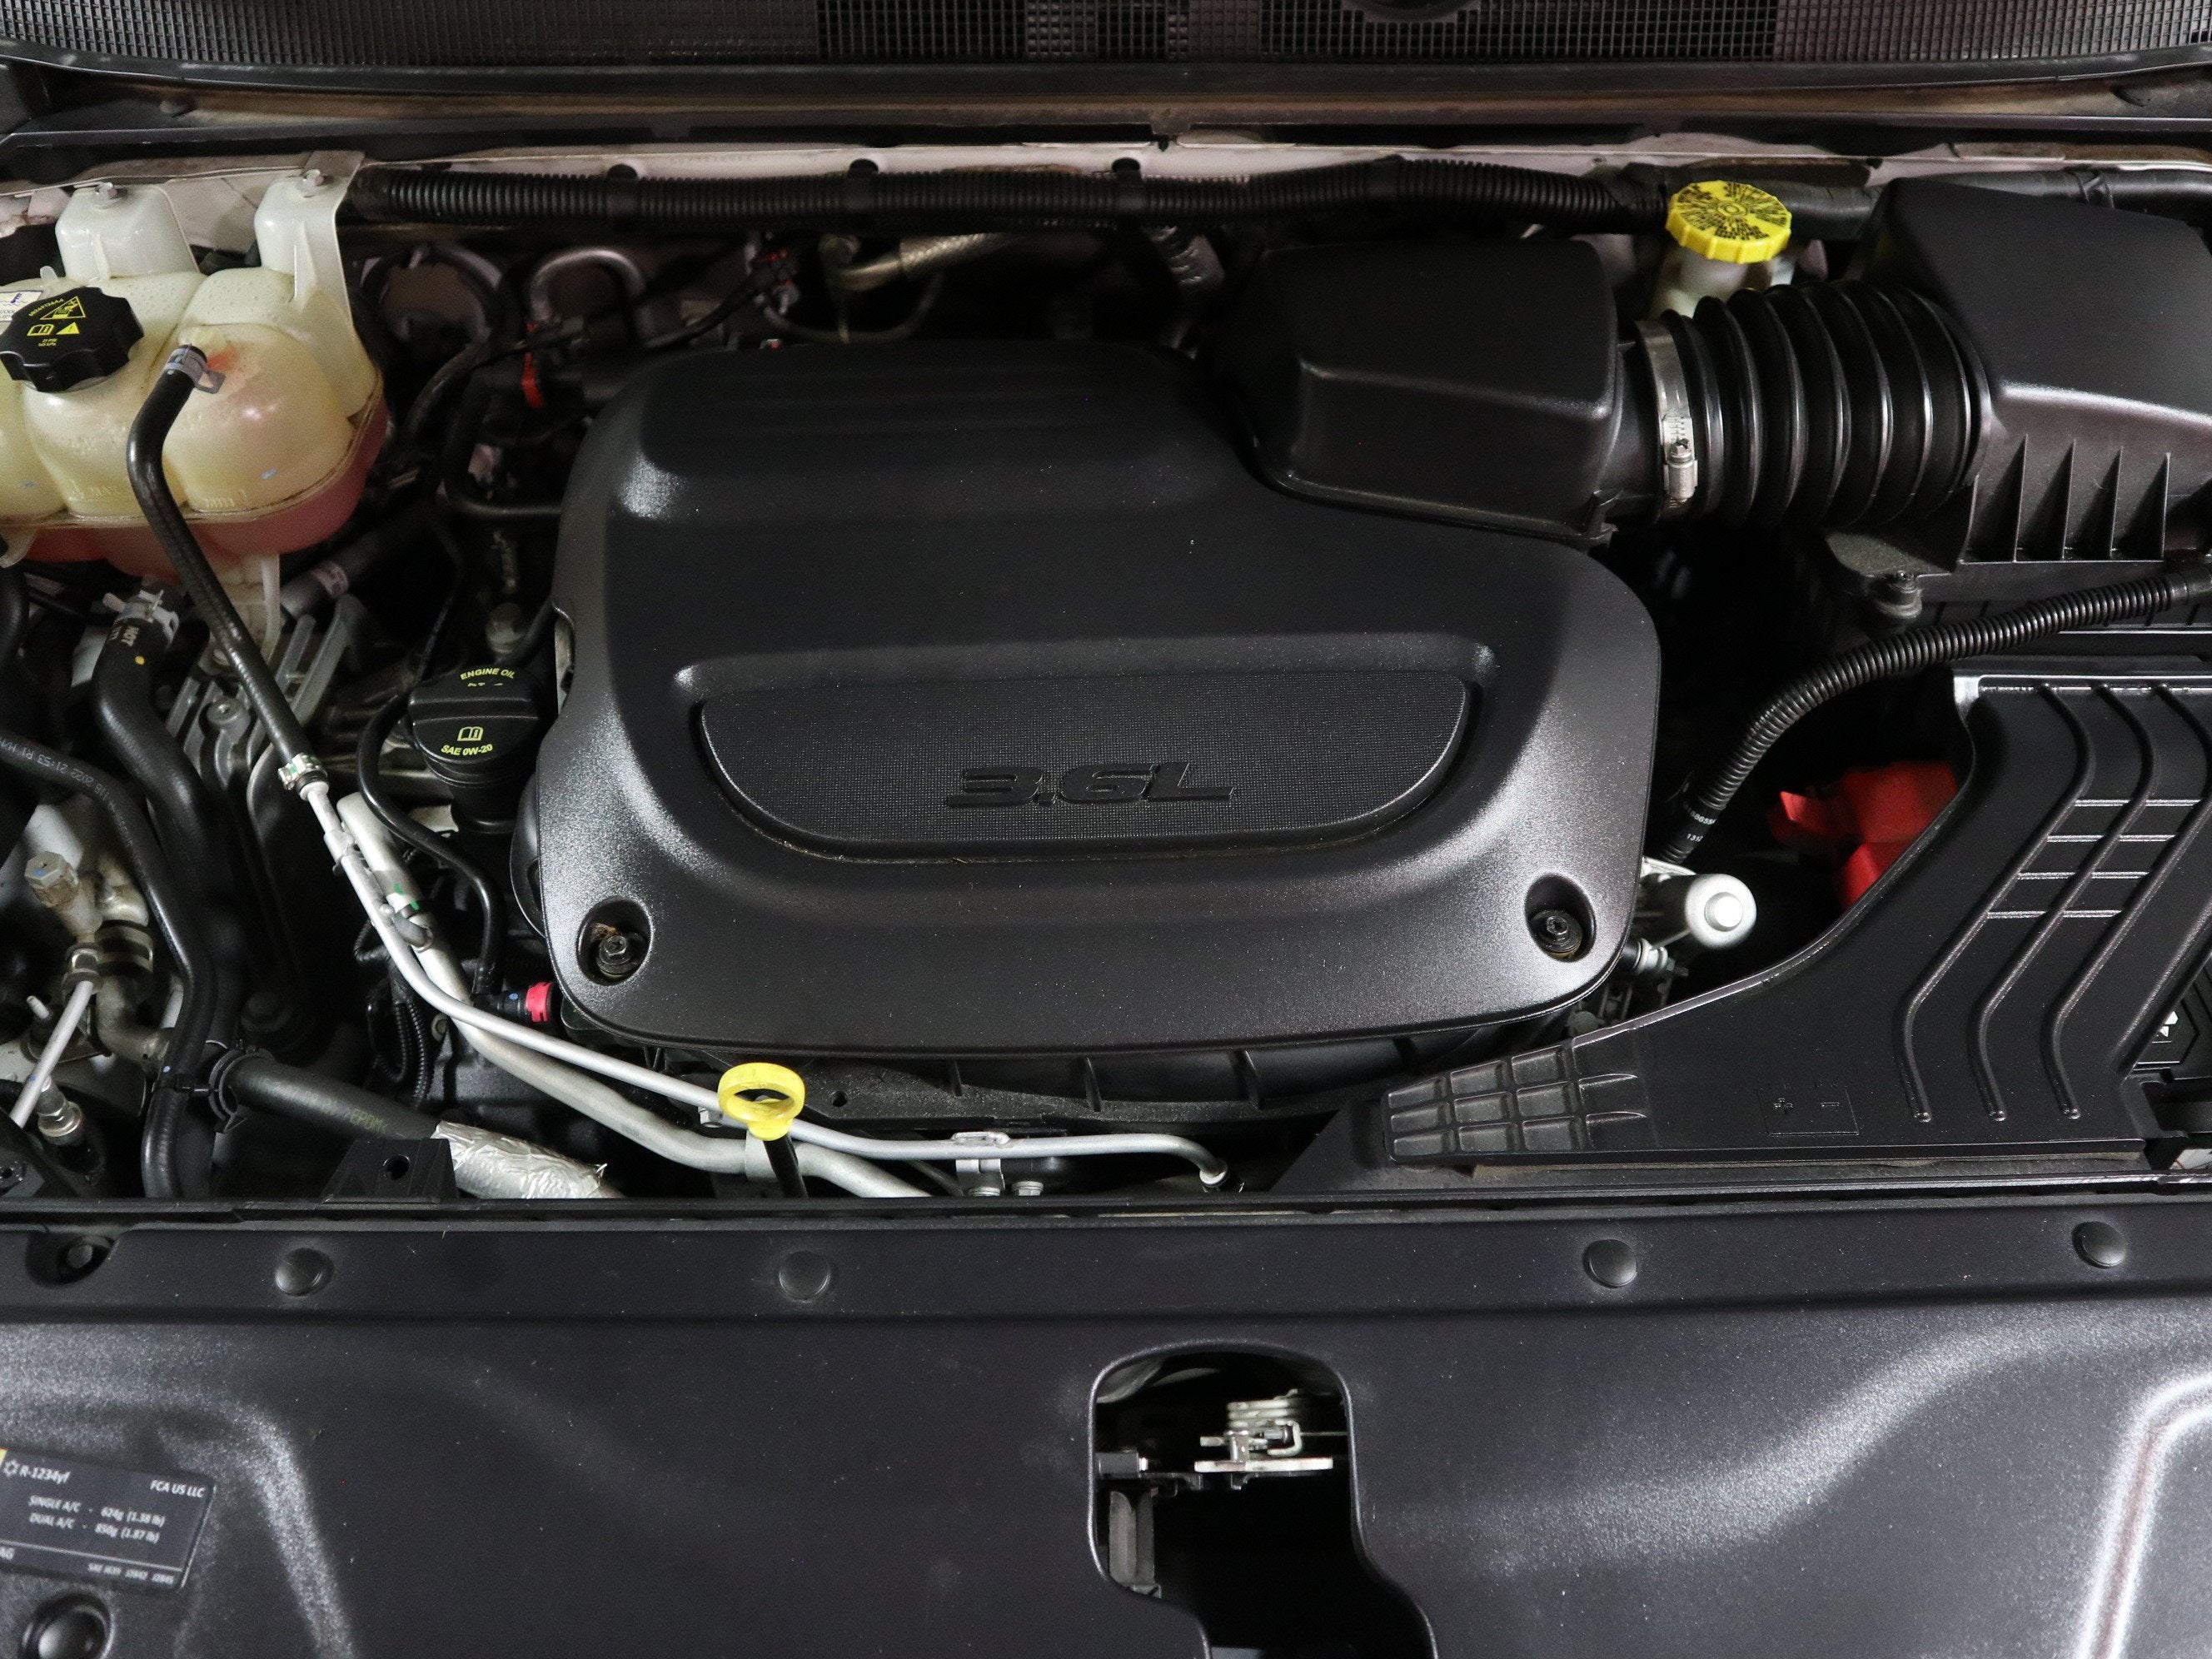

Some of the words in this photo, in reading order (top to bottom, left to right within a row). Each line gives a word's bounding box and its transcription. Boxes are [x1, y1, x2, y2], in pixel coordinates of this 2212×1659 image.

[460, 668, 499, 680] ENGINE
[501, 669, 516, 679] OIL
[441, 745, 461, 756] SAE
[462, 744, 493, 756] 0W-20
[947, 761, 1234, 808] 3.6L
[19, 1464, 71, 1485] R-1234yf
[151, 1479, 171, 1493] FCA
[172, 1482, 187, 1496] US
[187, 1485, 207, 1498] LLC
